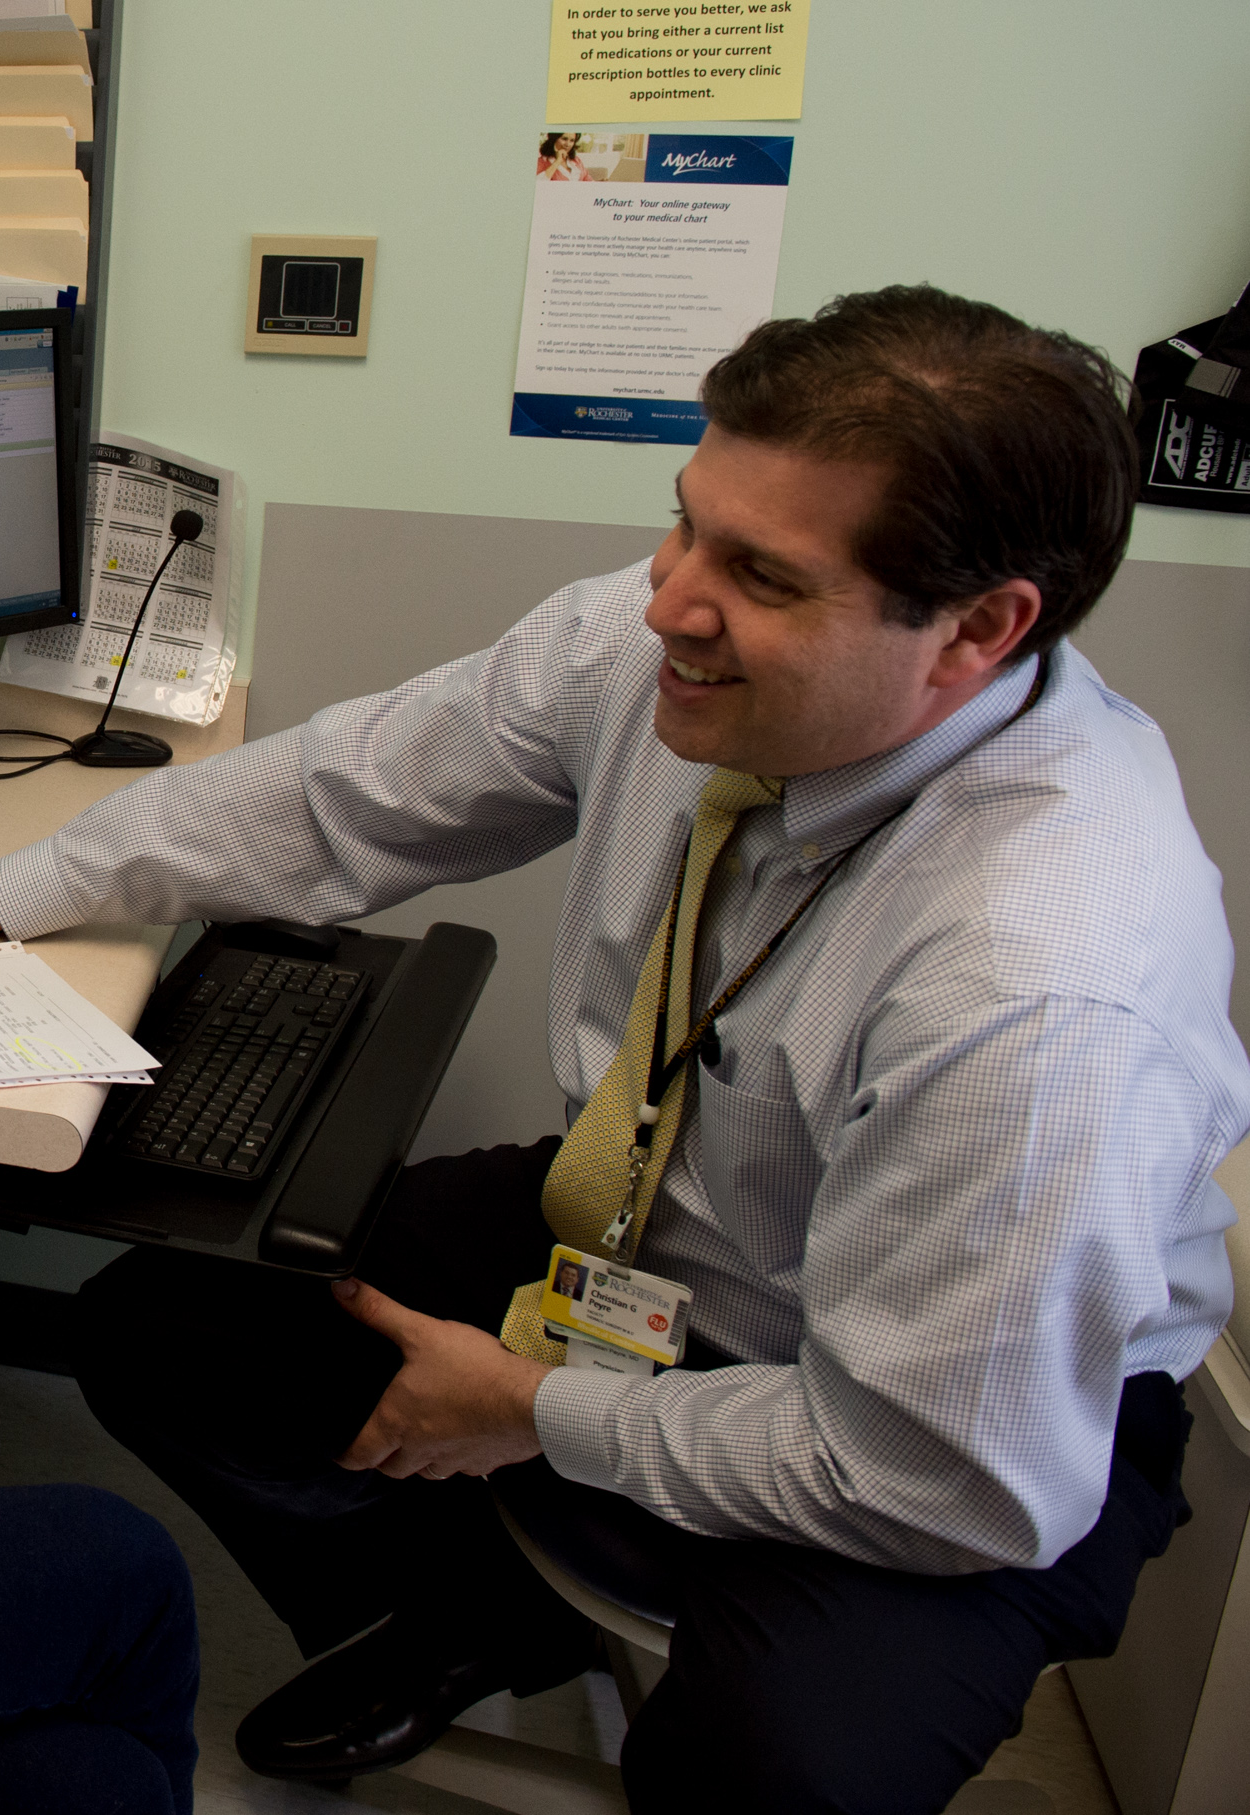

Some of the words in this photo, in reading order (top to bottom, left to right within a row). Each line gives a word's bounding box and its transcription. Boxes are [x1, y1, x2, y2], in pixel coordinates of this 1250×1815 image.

[568, 9, 579, 19] In
[583, 8, 616, 18] order
[620, 8, 633, 17] to
[637, 8, 670, 17] serve
[674, 7, 696, 18] you
[701, 4, 744, 15] better,
[748, 4, 767, 13] we
[771, 1, 792, 12] ask
[572, 29, 597, 40] that
[601, 30, 623, 41] you
[627, 27, 659, 39] bring
[663, 26, 700, 37] either
[704, 28, 711, 36] a
[715, 24, 761, 35] current
[765, 23, 784, 33] list
[581, 49, 593, 60] of
[596, 48, 672, 59] medications
[676, 48, 690, 57] or
[693, 47, 721, 59] your
[725, 45, 772, 56] current
[568, 69, 642, 83] prescription
[646, 67, 690, 79] bottles
[694, 68, 707, 77] to
[710, 66, 746, 79] every
[749, 65, 781, 76] clinic
[630, 88, 714, 101] appointment.
[661, 150, 737, 176] MyChart
[593, 198, 634, 208] MyChart:
[640, 199, 659, 208] Your
[662, 200, 689, 208] online
[691, 201, 730, 211] gateway
[613, 213, 622, 221] to
[624, 215, 644, 223] your
[647, 214, 682, 222] medical
[684, 214, 708, 223] chart
[588, 407, 633, 419] ROCHESTER
[1164, 410, 1191, 479] ADC
[1210, 447, 1223, 477] Reusable
[591, 1289, 627, 1309] Christian
[610, 1278, 670, 1310] ROCHESTER
[588, 1298, 612, 1312] Peyre
[650, 1316, 666, 1328] FLU
[593, 1360, 624, 1374] Physician
